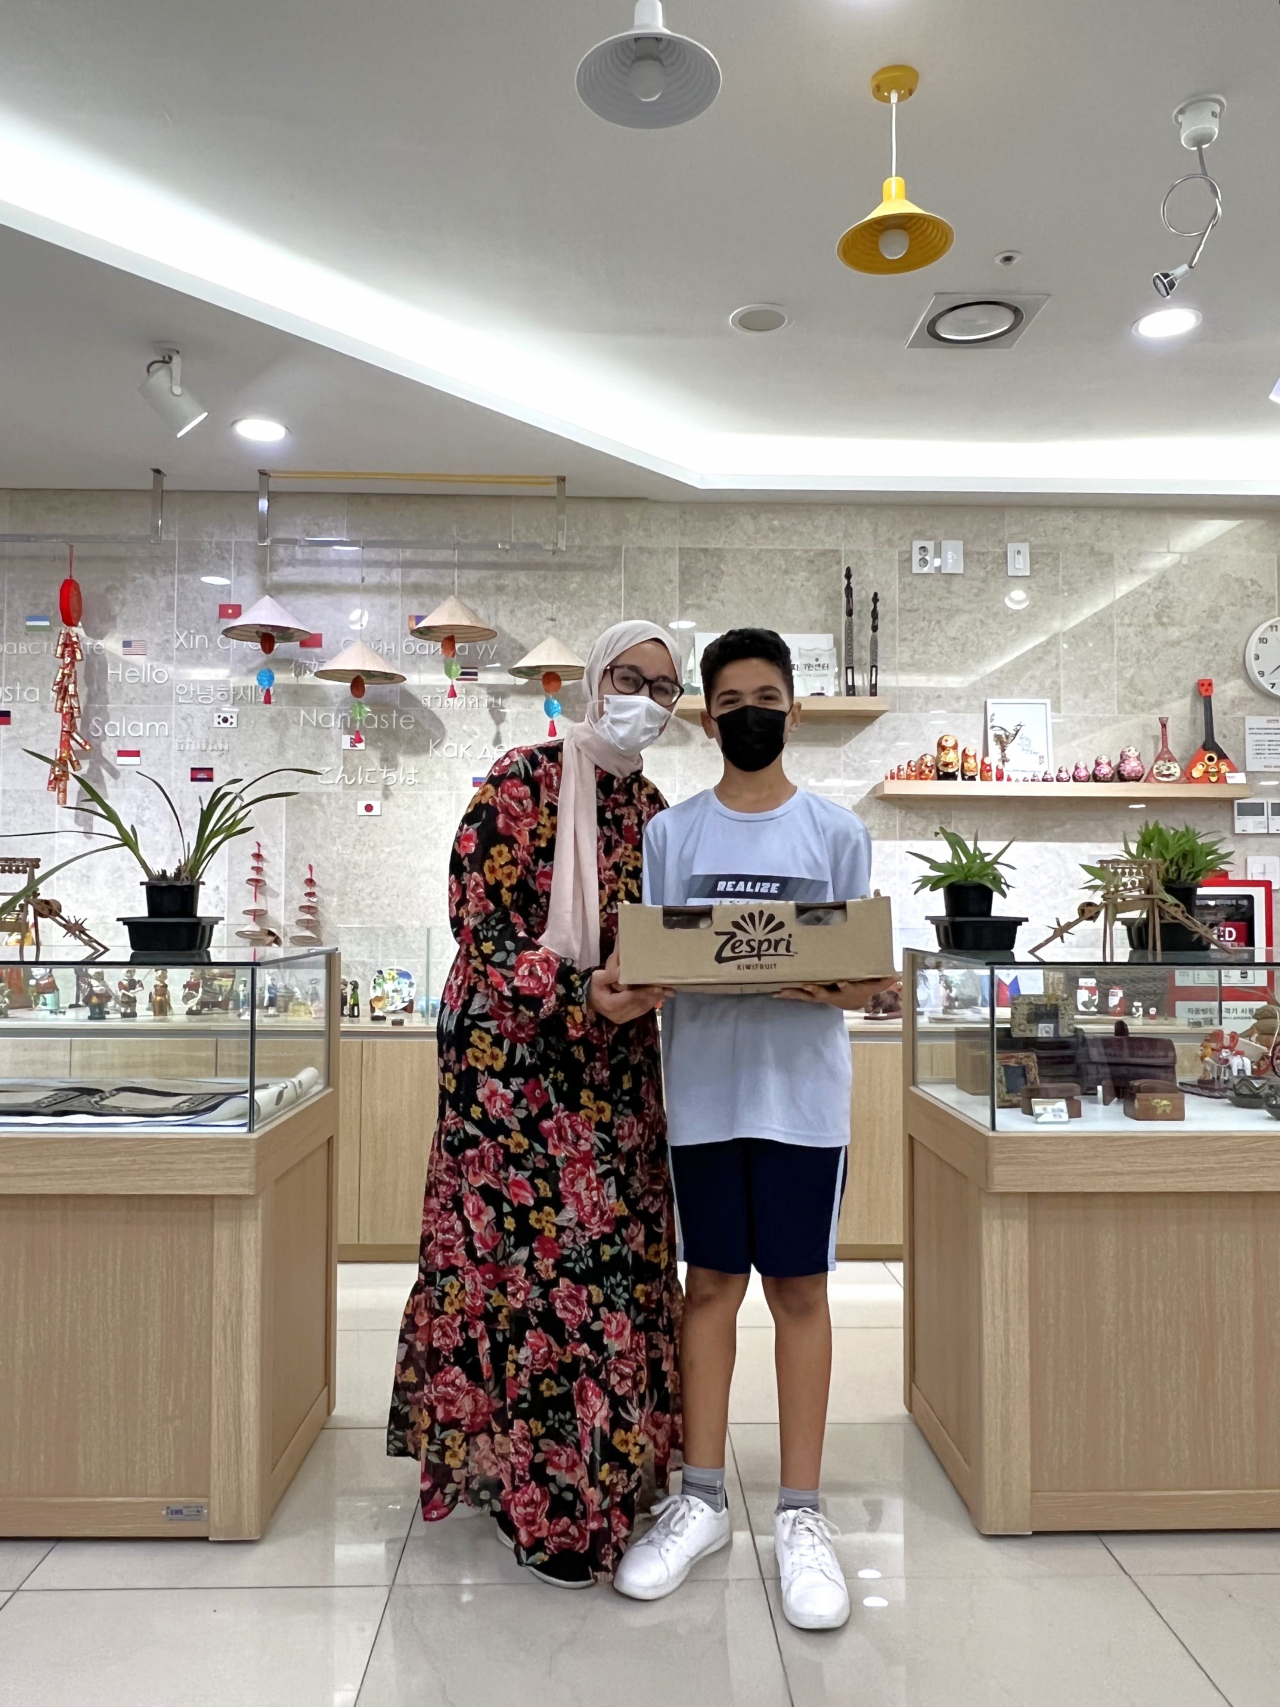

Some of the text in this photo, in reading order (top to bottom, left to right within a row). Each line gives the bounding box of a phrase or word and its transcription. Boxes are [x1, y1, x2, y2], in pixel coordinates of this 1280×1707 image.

[174, 630, 209, 649] Xin
[476, 643, 498, 660] уу
[107, 663, 169, 684] Hello
[0, 681, 40, 703] sta
[175, 683, 277, 705] 안녕하세요
[91, 717, 169, 738] Salam
[300, 708, 415, 730] Namaste
[428, 738, 473, 759] Как
[318, 765, 420, 787] こんにちは
[716, 881, 780, 893] REALIZE
[714, 932, 795, 964] Zespri
[736, 963, 777, 971] KIWIFRUIT
